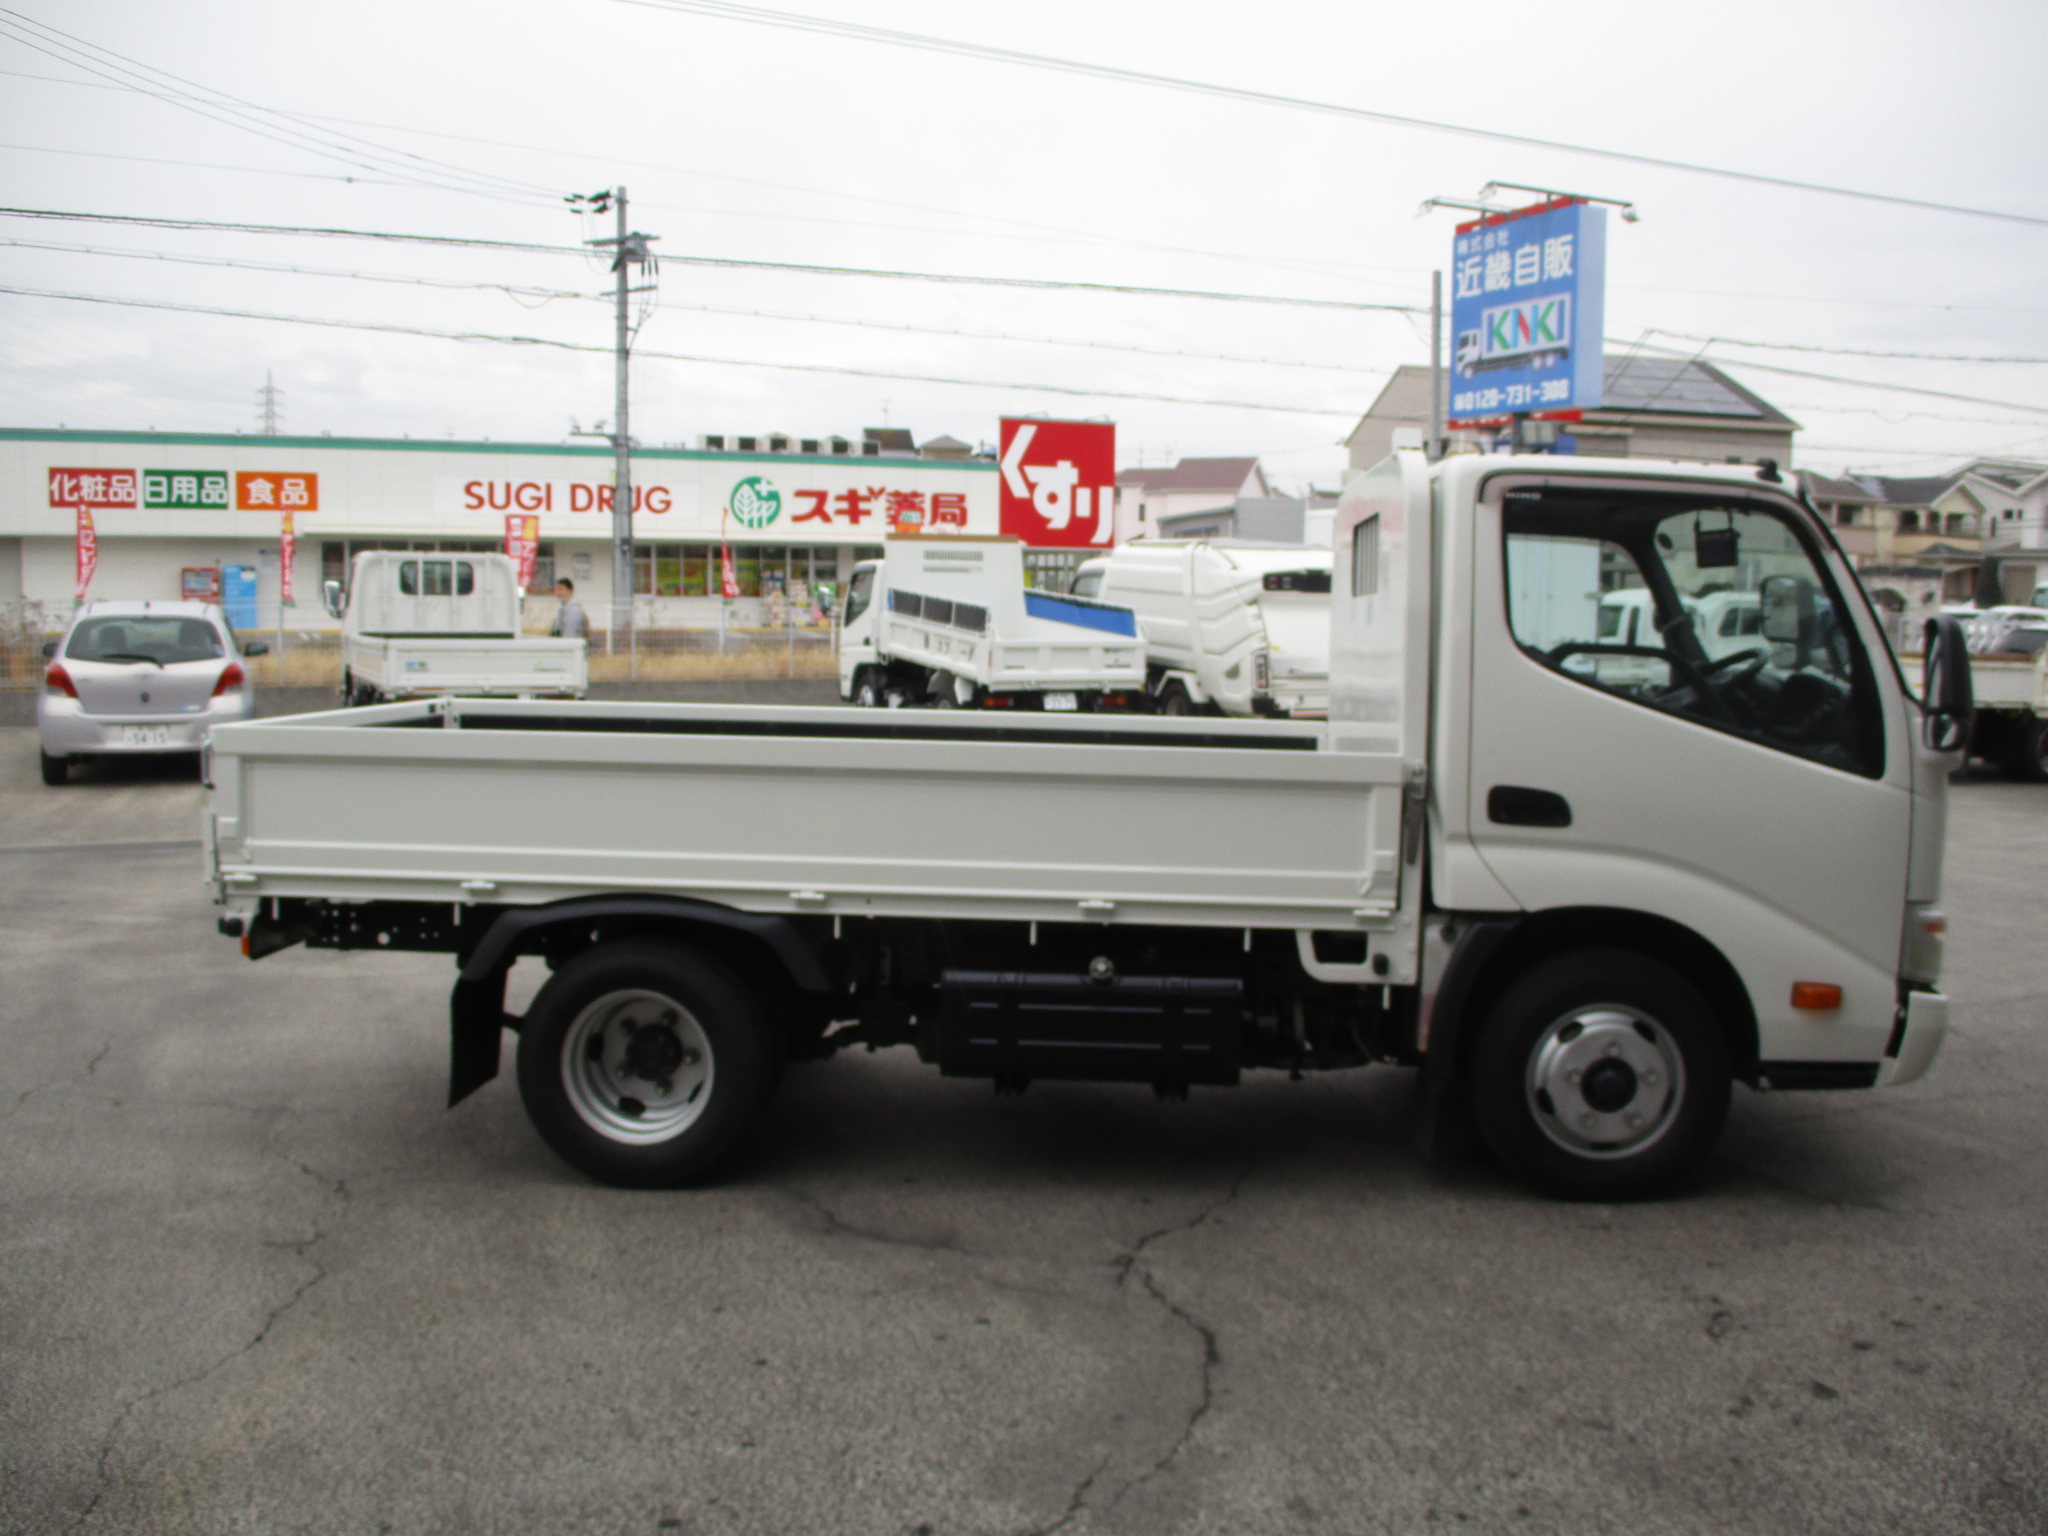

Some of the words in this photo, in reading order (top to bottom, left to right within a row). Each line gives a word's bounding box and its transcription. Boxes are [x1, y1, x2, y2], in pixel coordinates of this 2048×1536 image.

[1456, 233, 1575, 298] 近畿自販
[50, 473, 137, 502] 化粧品
[145, 475, 228, 504] 日用品
[246, 477, 309, 505] 食品
[464, 480, 552, 512] SUGI
[1000, 423, 1114, 544] くすり
[791, 486, 968, 527] スギ薬局
